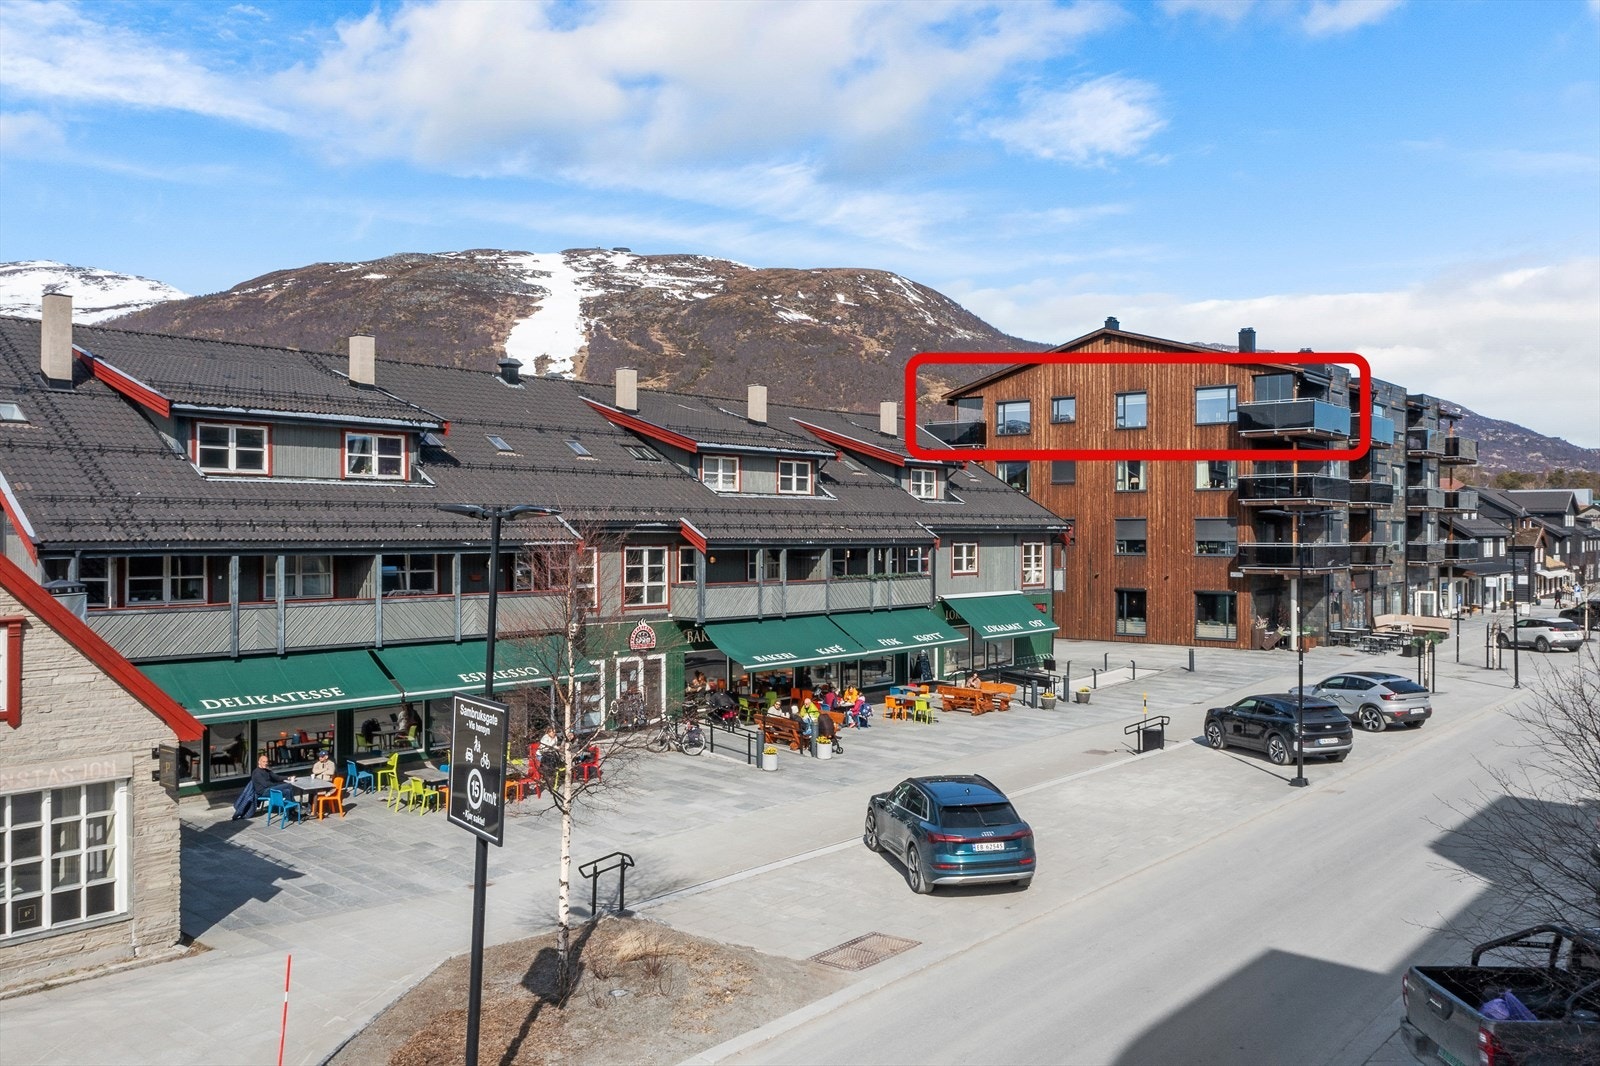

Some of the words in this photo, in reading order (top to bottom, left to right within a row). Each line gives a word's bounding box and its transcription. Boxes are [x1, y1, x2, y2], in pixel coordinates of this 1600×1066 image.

[983, 622, 1024, 633] LOKALMAT
[1028, 619, 1046, 628] OST
[877, 637, 904, 647] FISK
[912, 632, 945, 643] KJØTT
[752, 652, 798, 663] BAKERI
[200, 686, 346, 710] DELIKATESSE
[460, 703, 498, 726] Sambruksgate
[471, 780, 480, 798] 15
[483, 788, 497, 806] km/t
